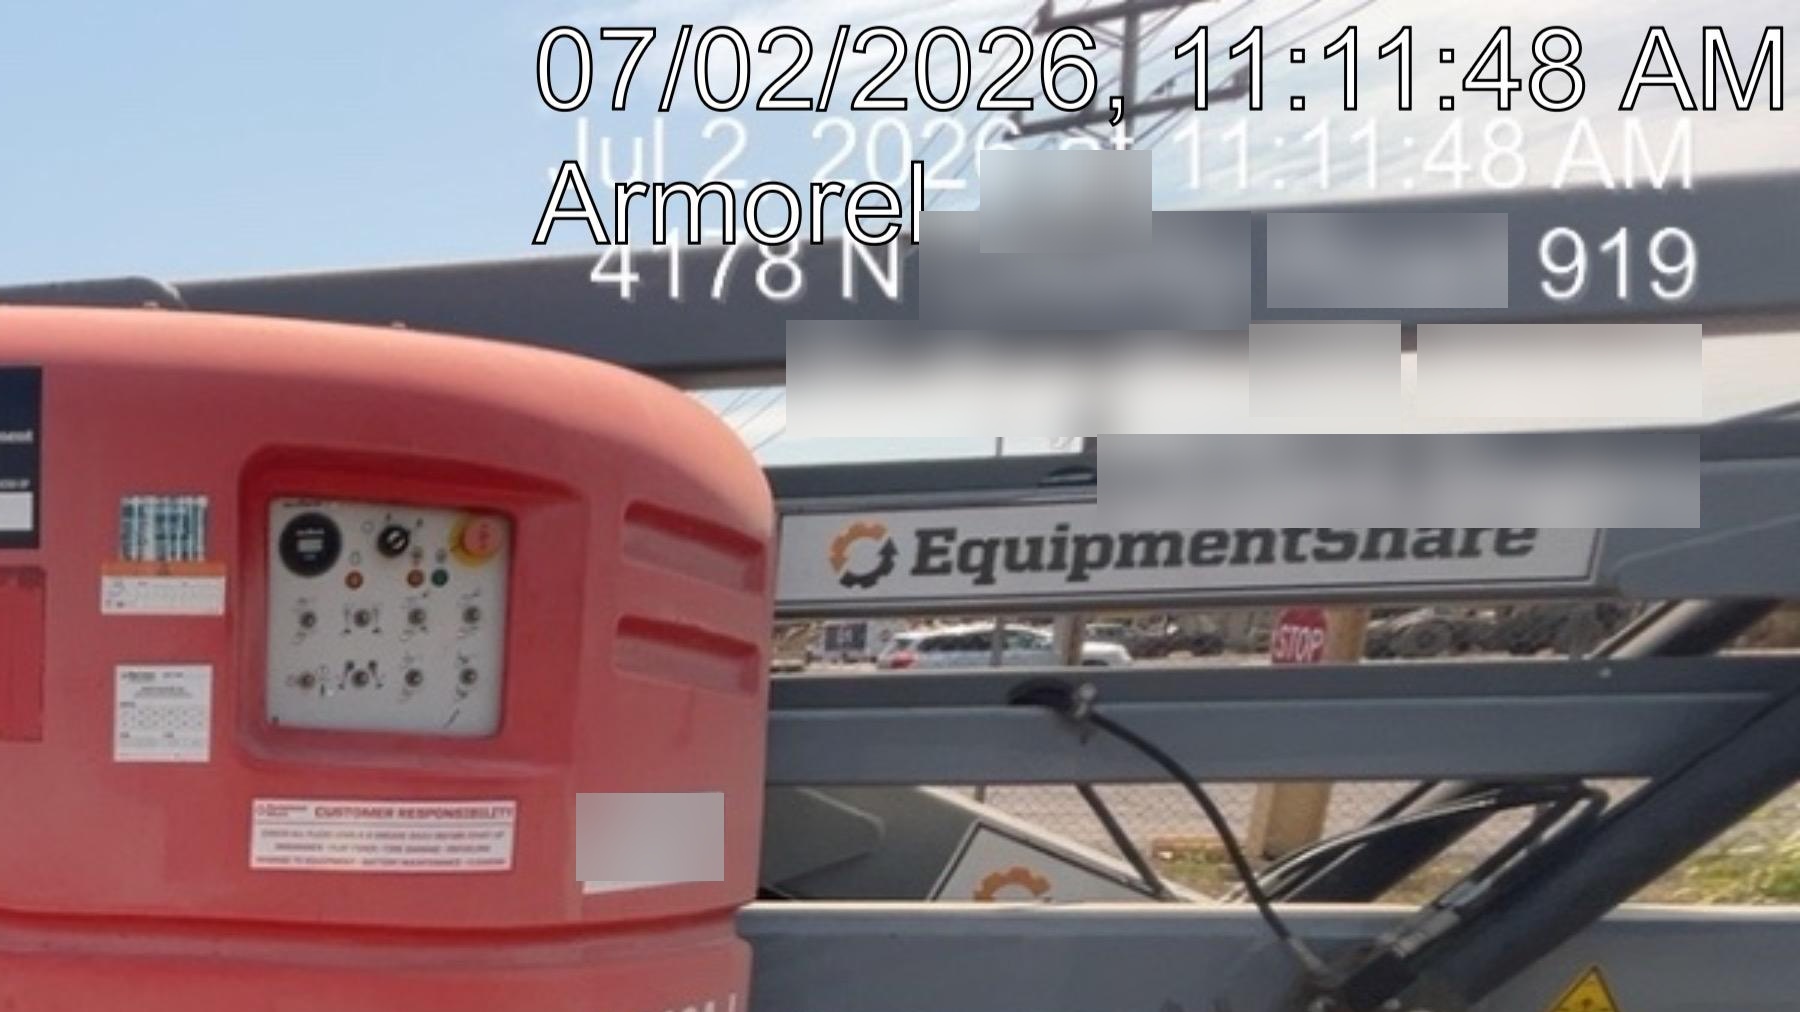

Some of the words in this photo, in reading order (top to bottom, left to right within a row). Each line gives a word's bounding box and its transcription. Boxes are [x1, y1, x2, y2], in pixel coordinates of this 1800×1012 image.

[910, 522, 1538, 586] EquipmentShare
[1272, 623, 1323, 662] STOP
[314, 805, 394, 820] CUSTOMER
